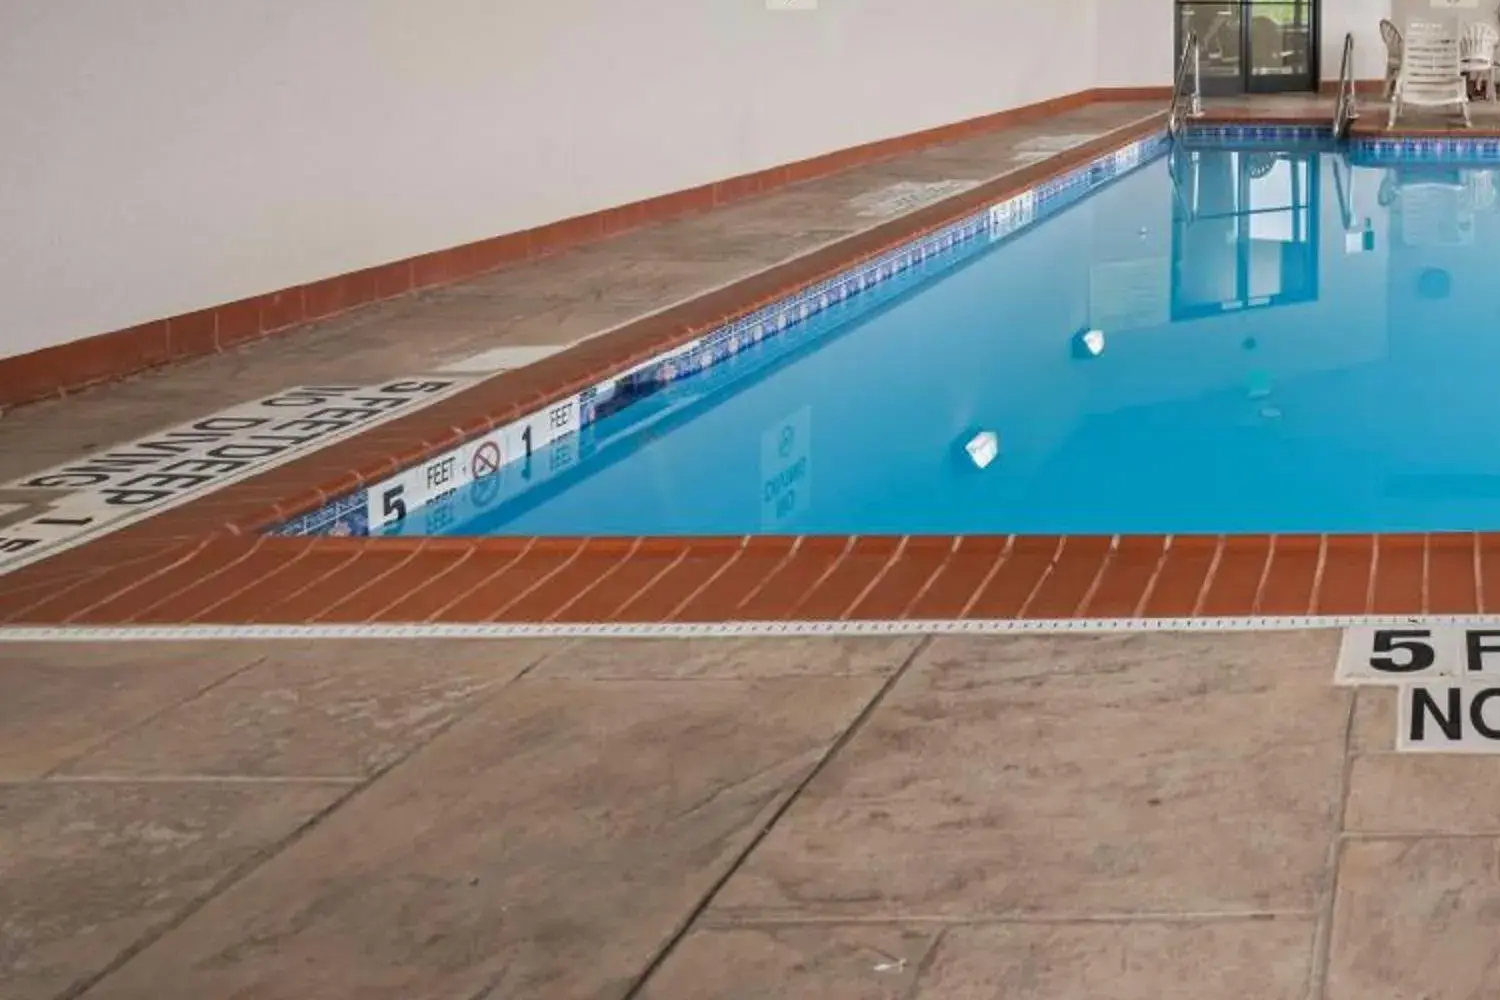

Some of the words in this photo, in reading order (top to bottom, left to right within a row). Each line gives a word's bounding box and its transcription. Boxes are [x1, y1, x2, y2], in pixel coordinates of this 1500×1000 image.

[20, 417, 270, 487] DIVING
[384, 486, 406, 522] 5
[427, 457, 456, 489] FEET
[521, 425, 532, 458] 1
[550, 403, 573, 429] FEET
[1369, 629, 1435, 673] 5
